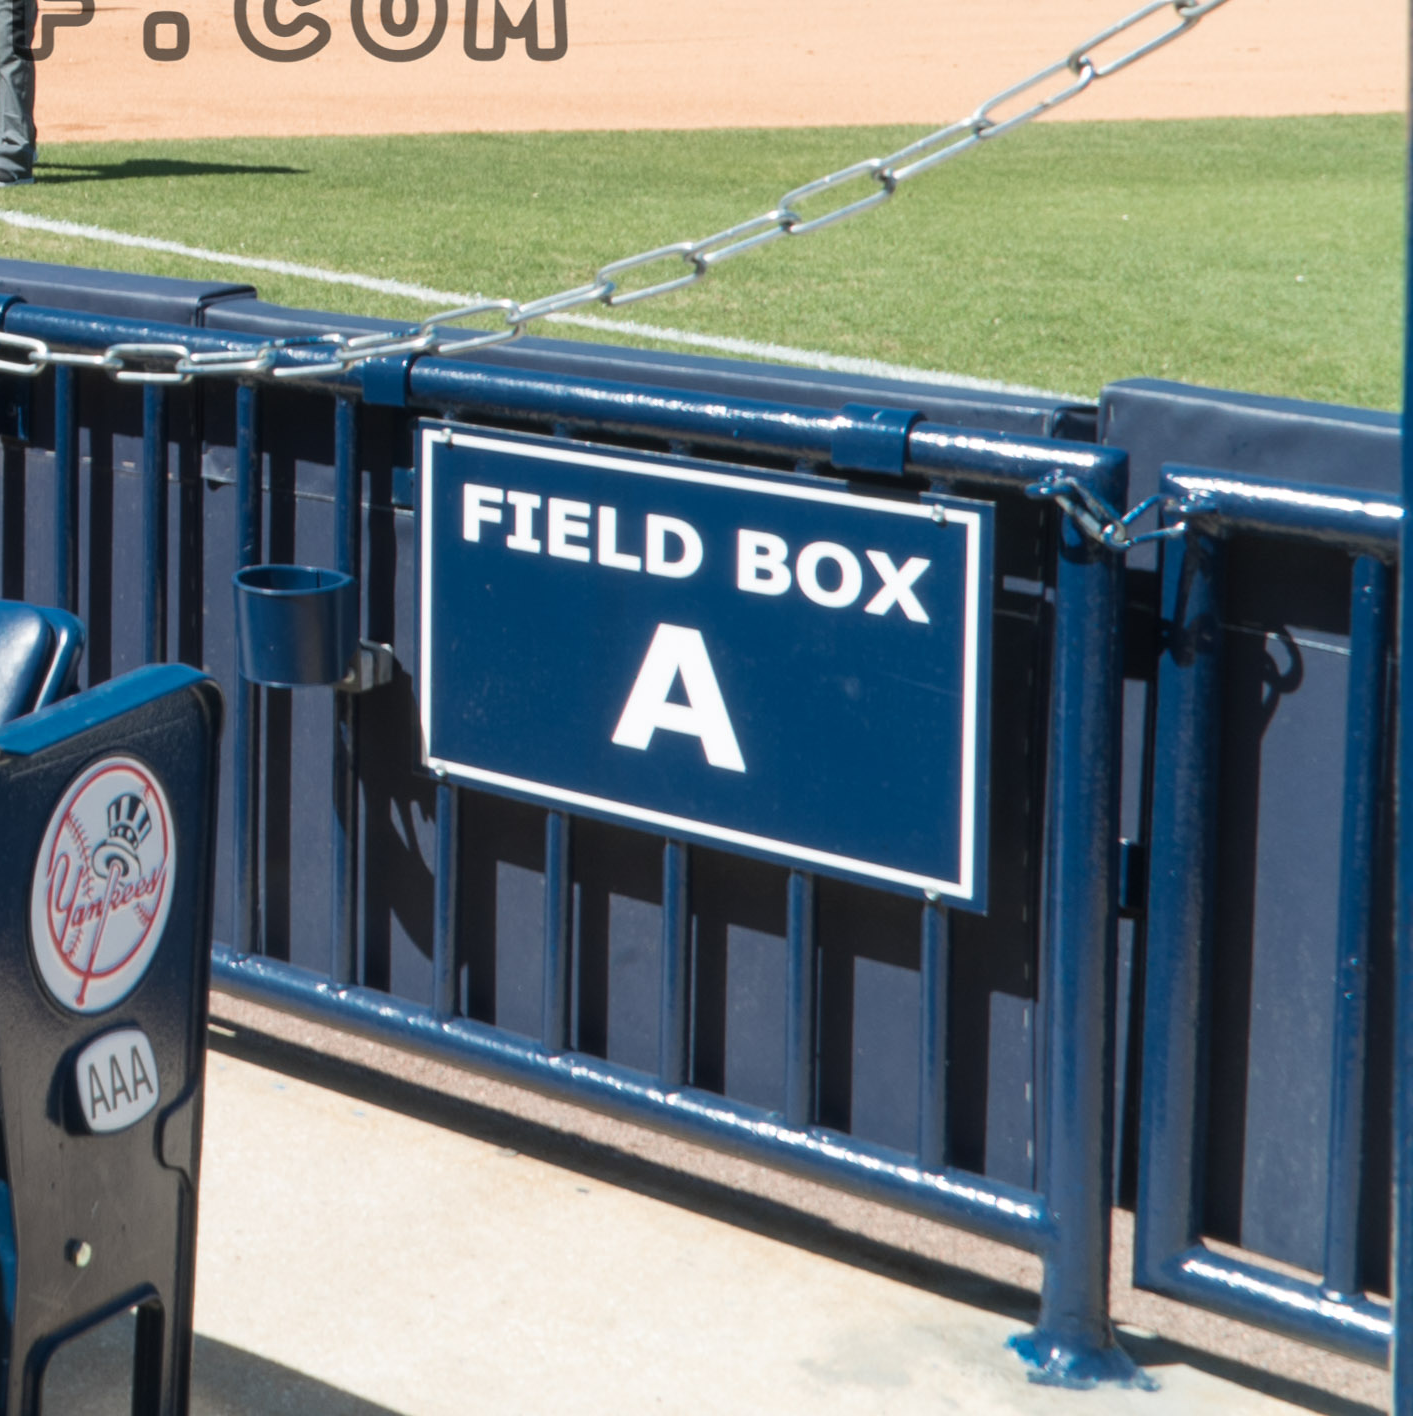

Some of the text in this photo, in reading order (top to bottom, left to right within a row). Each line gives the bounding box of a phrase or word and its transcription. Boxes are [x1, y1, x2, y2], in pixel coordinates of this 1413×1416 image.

[462, 482, 932, 625] FIELD BOX
[610, 622, 747, 774] A
[49, 853, 162, 948] Yankees
[87, 1045, 154, 1120] AAA
